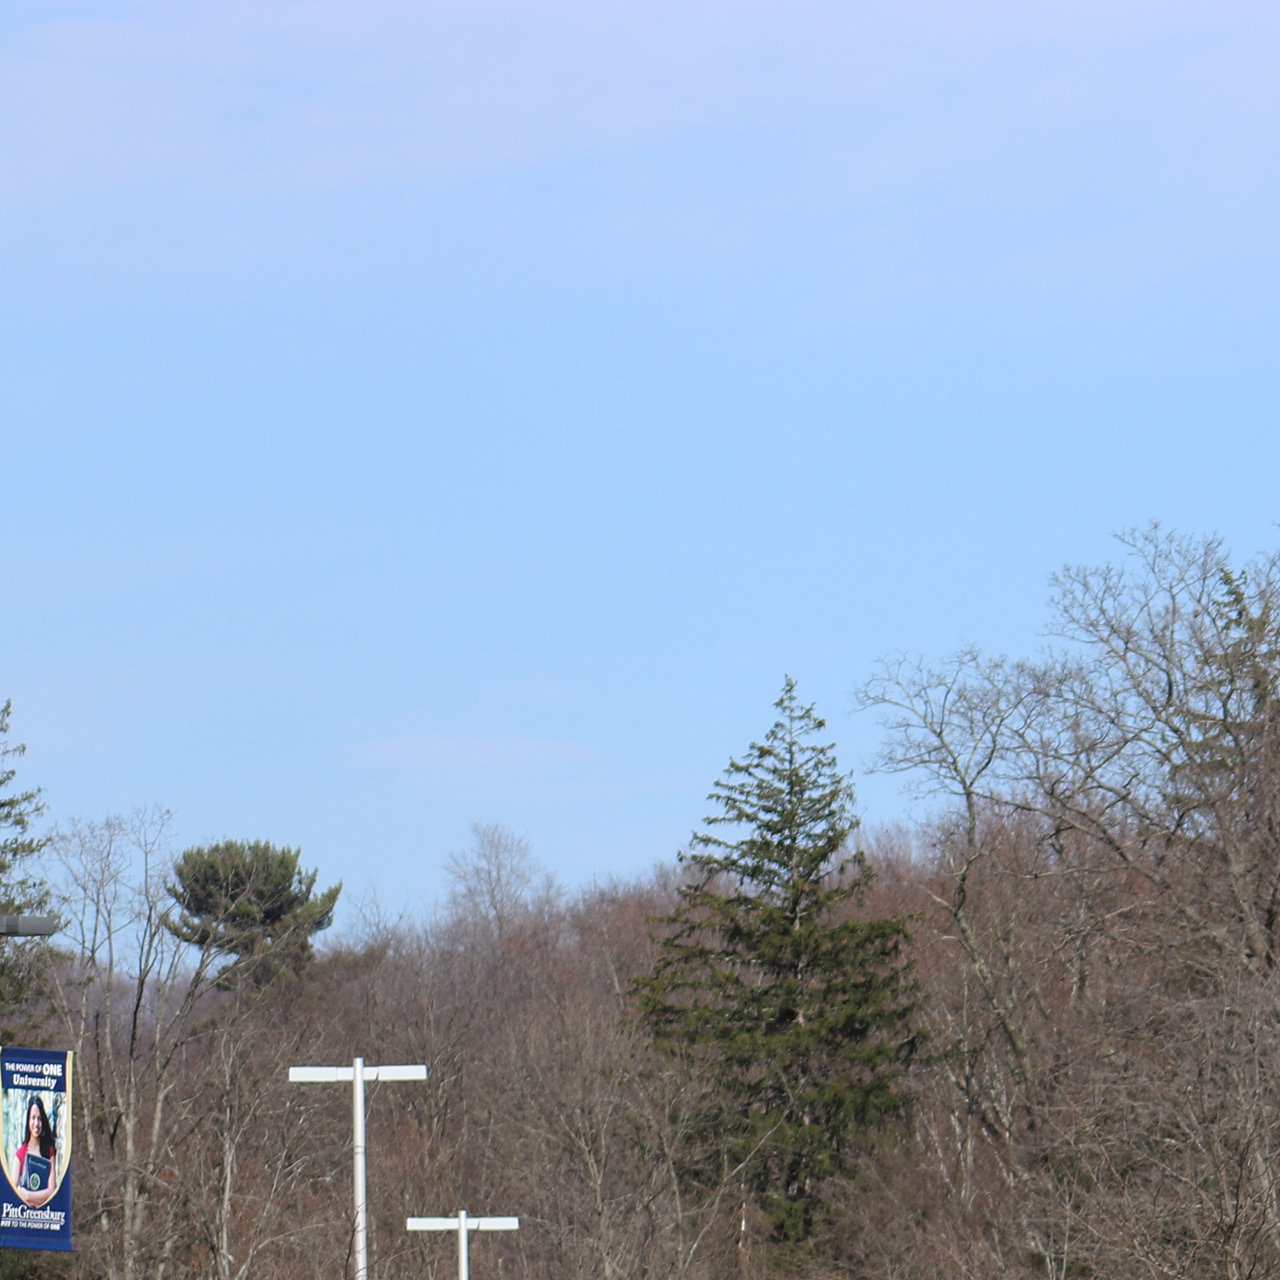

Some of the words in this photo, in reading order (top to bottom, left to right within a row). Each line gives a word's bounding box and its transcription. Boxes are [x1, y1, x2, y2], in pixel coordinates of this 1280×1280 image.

[4, 1062, 16, 1071] THE
[15, 1063, 35, 1072] POWER
[34, 1064, 43, 1073] OF
[42, 1063, 63, 1076] ONE
[12, 1073, 57, 1090] University
[1, 1202, 66, 1226] PittGreensburg
